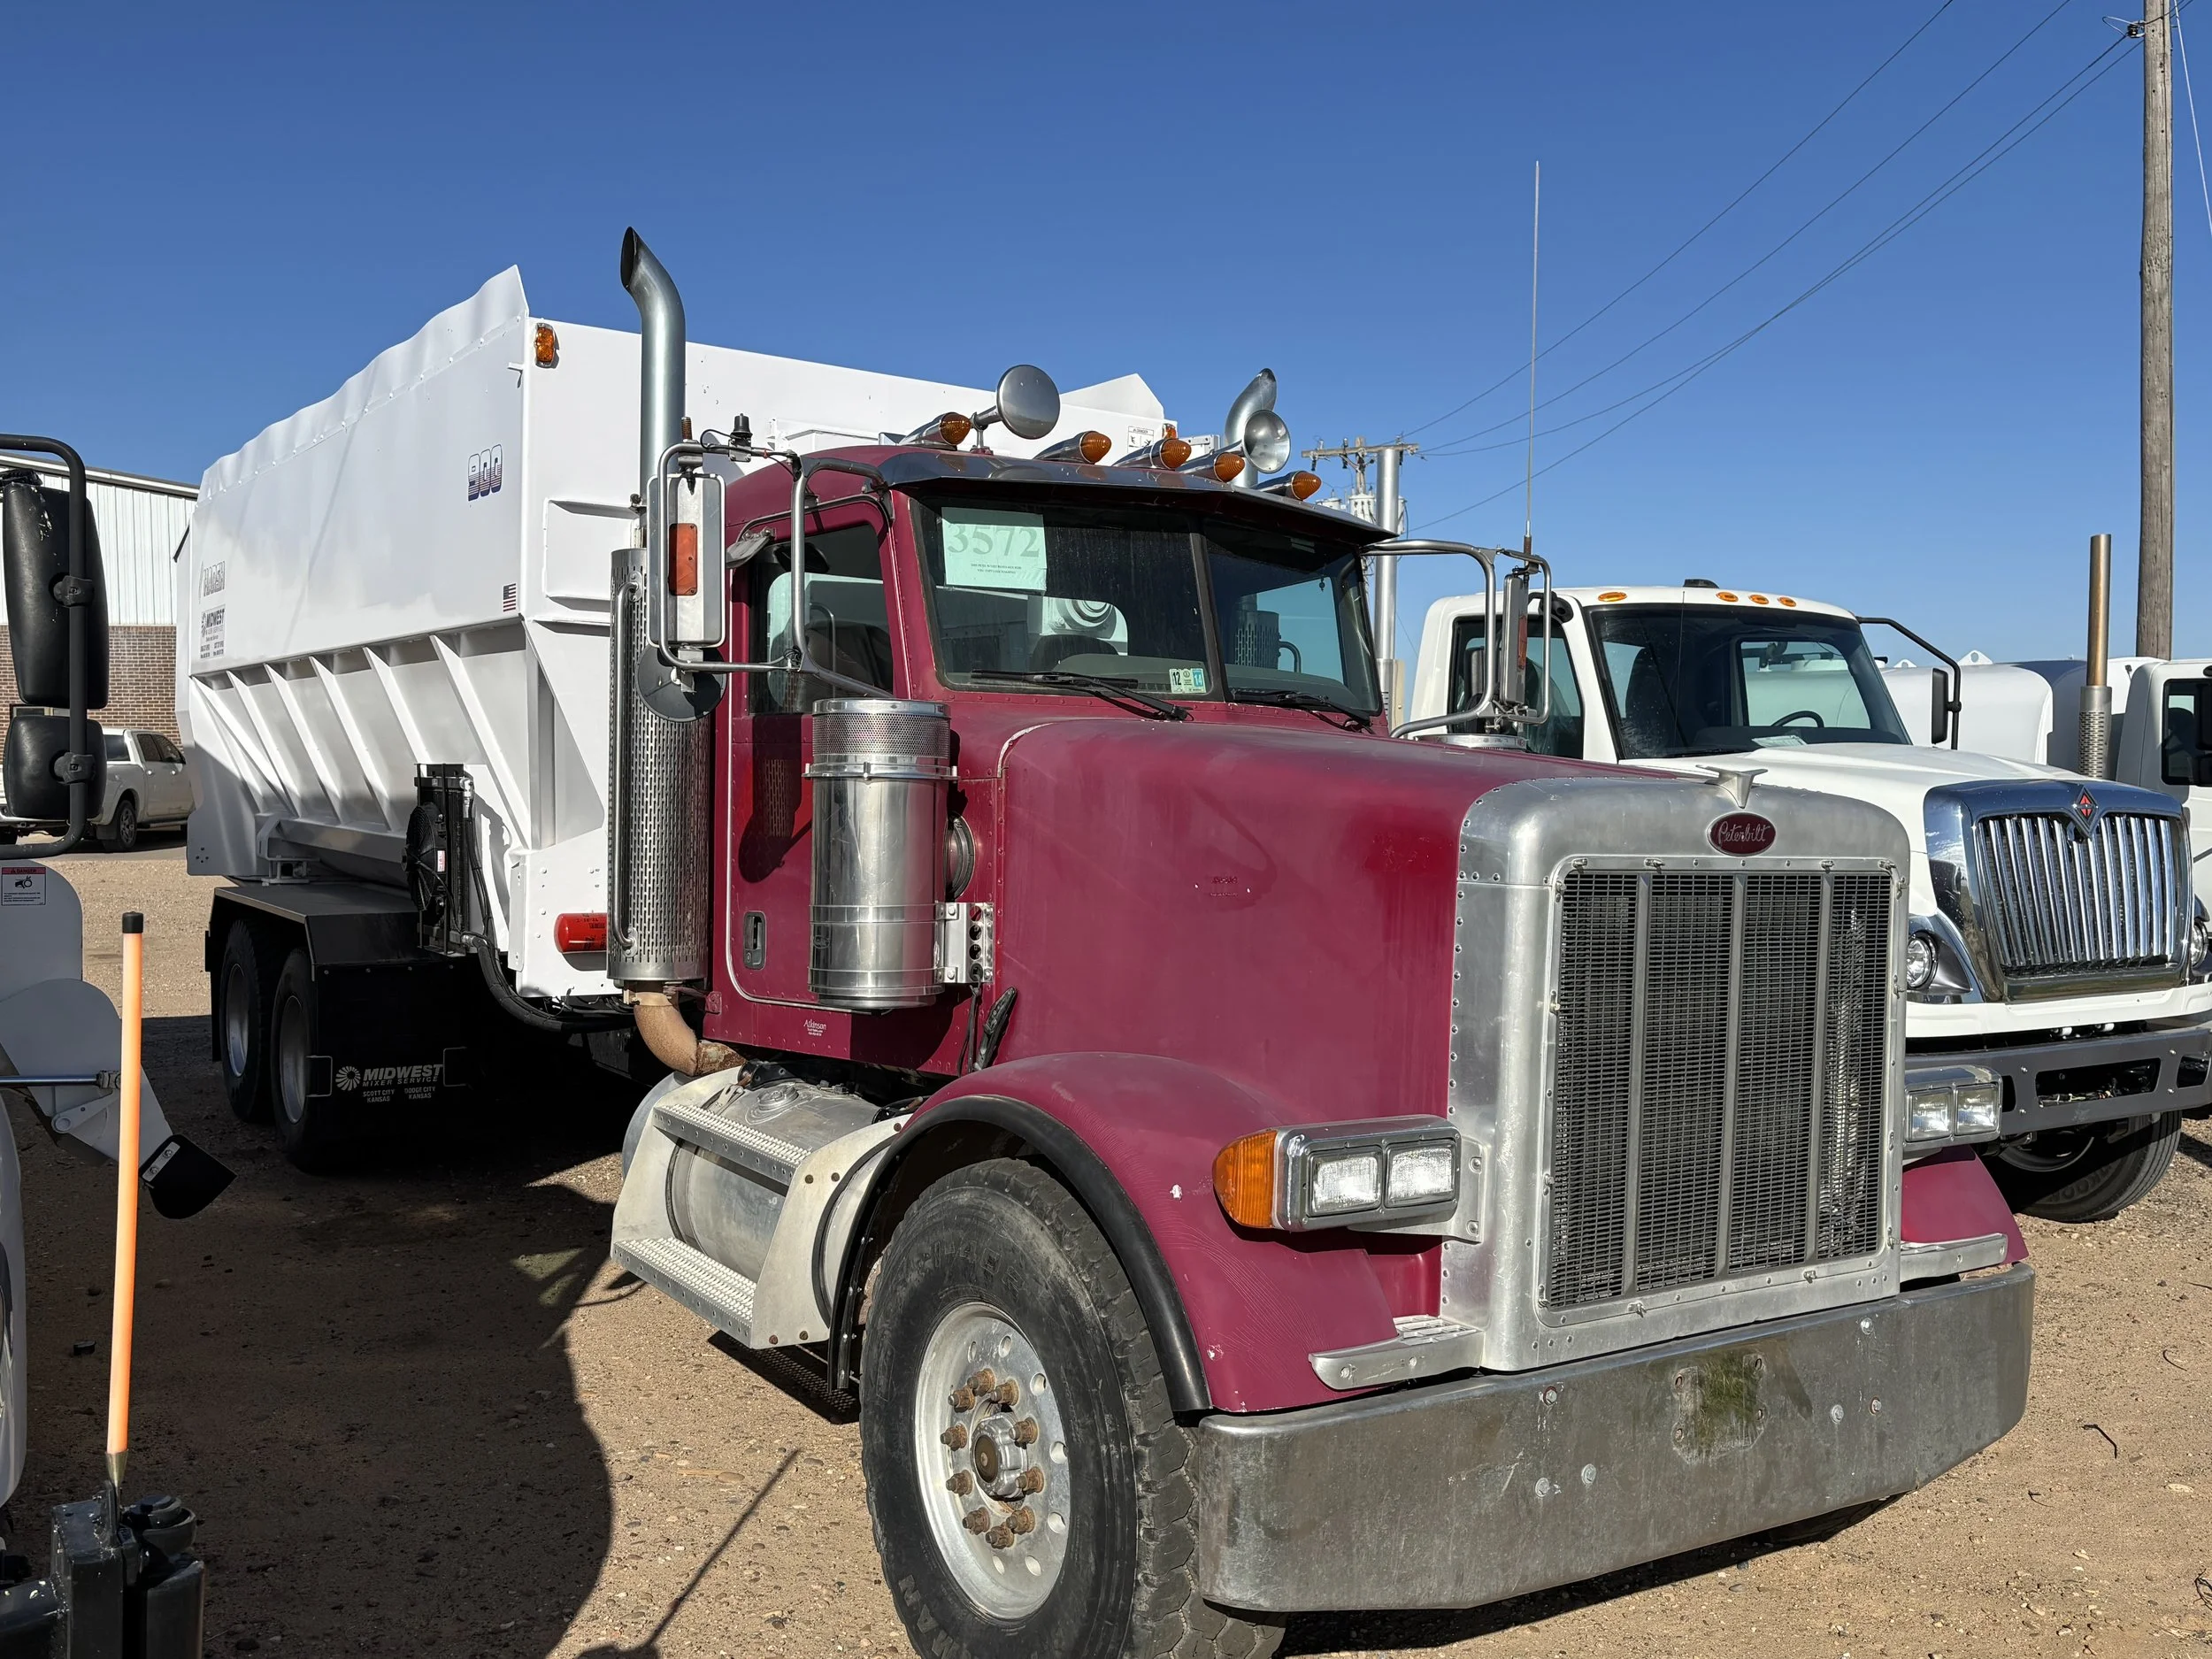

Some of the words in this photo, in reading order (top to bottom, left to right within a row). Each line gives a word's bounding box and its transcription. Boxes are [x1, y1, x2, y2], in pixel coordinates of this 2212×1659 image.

[468, 444, 503, 502] 900
[948, 522, 1041, 557] 3572
[1173, 672, 1181, 686] 12
[1194, 674, 1202, 686] 14
[1717, 820, 1770, 845] Peterbilt
[803, 1018, 827, 1030] Atkinson
[363, 1064, 443, 1081] MIDWEST
[396, 1076, 439, 1085] SERVICE
